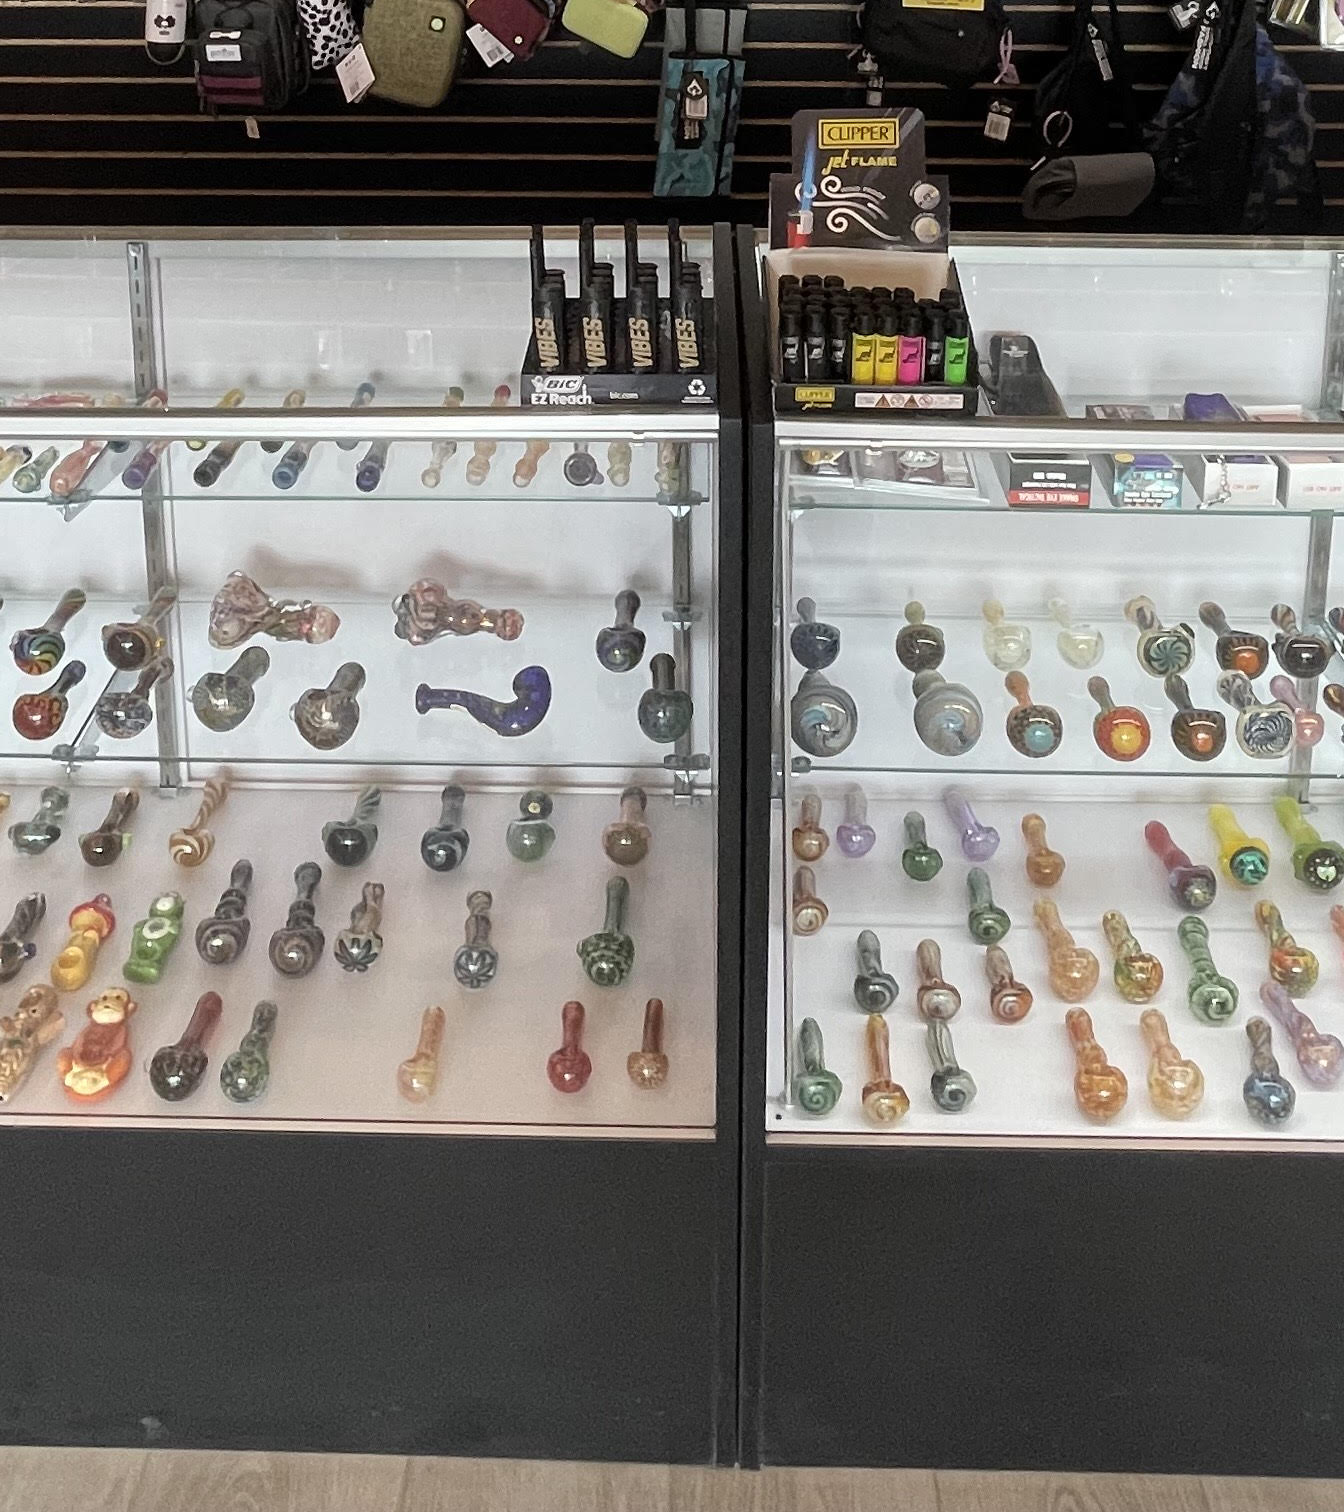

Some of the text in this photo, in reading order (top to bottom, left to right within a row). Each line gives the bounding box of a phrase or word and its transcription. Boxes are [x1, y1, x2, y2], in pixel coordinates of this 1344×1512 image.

[827, 126, 889, 141] CLIPPER
[851, 156, 897, 166] FLAME
[535, 317, 559, 368] VIBES
[583, 317, 607, 368] VIBES
[629, 317, 653, 368] VIBES
[675, 317, 699, 369] VIBES
[531, 386, 592, 405] EZ Reach
